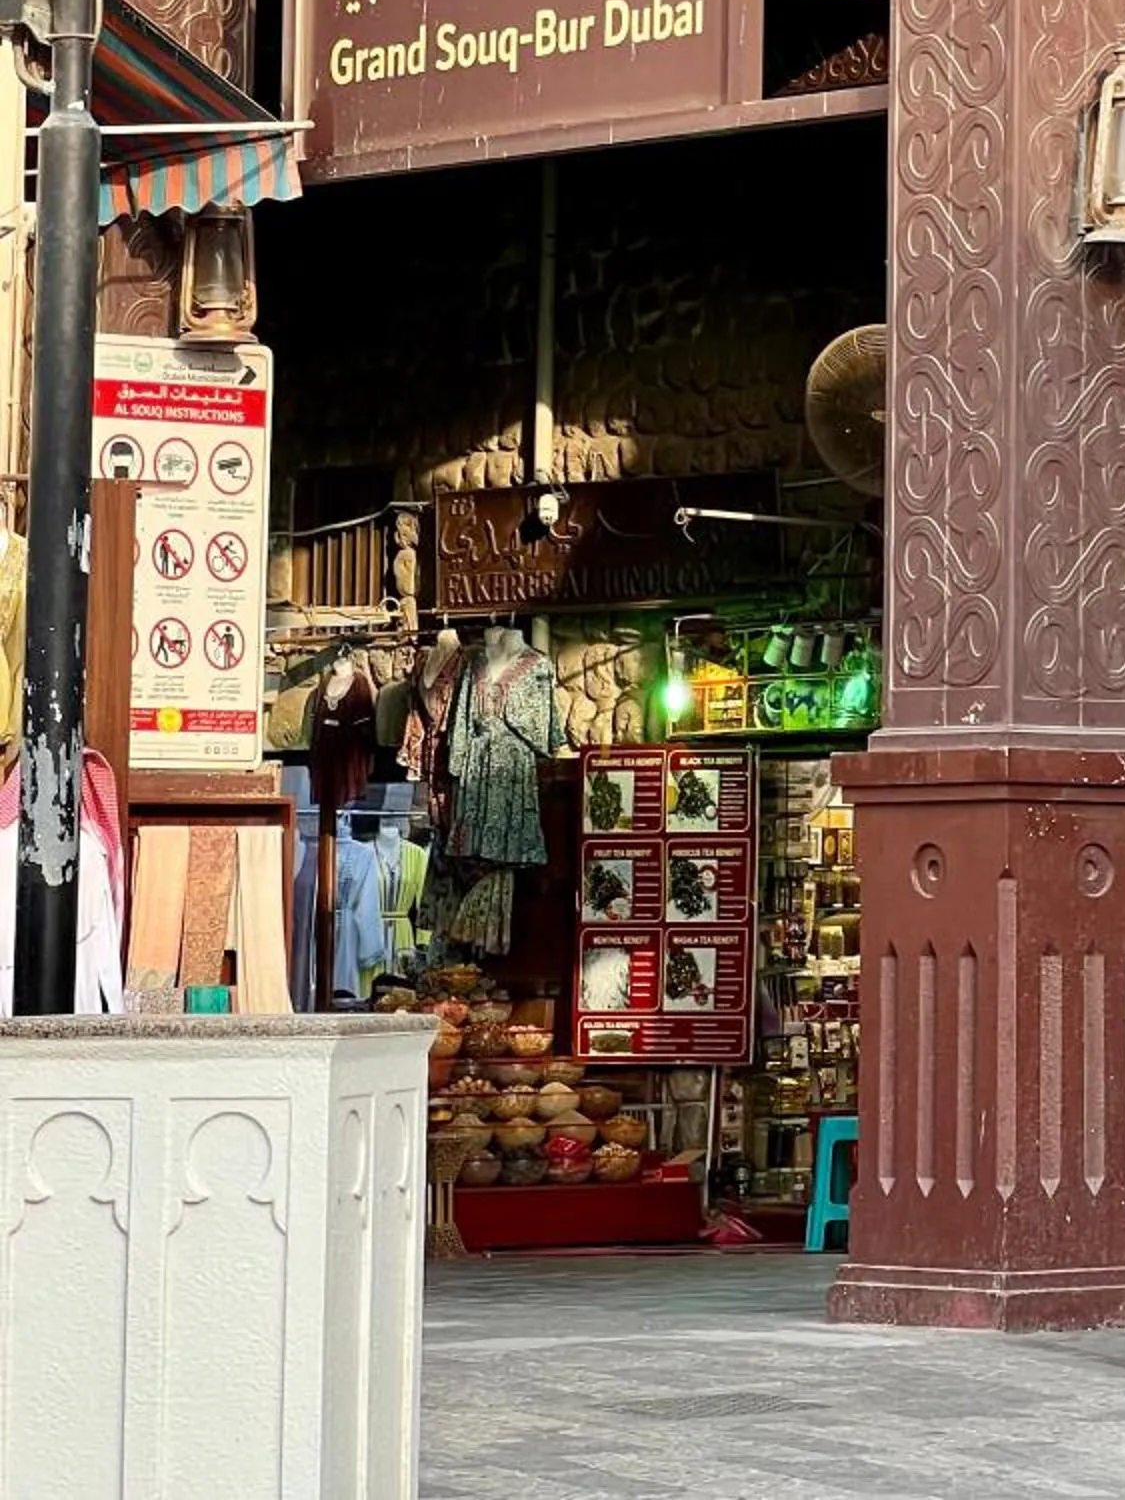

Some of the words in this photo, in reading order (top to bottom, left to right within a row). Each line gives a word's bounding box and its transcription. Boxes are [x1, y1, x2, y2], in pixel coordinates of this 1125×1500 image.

[330, 24, 427, 85] Grand
[435, 9, 595, 73] Souq-Bur
[116, 383, 168, 400] السوق
[169, 386, 243, 406] تعليمات
[113, 403, 130, 415] AL
[131, 404, 163, 419] SOUQ
[164, 405, 247, 423] INSTRUCTIONS
